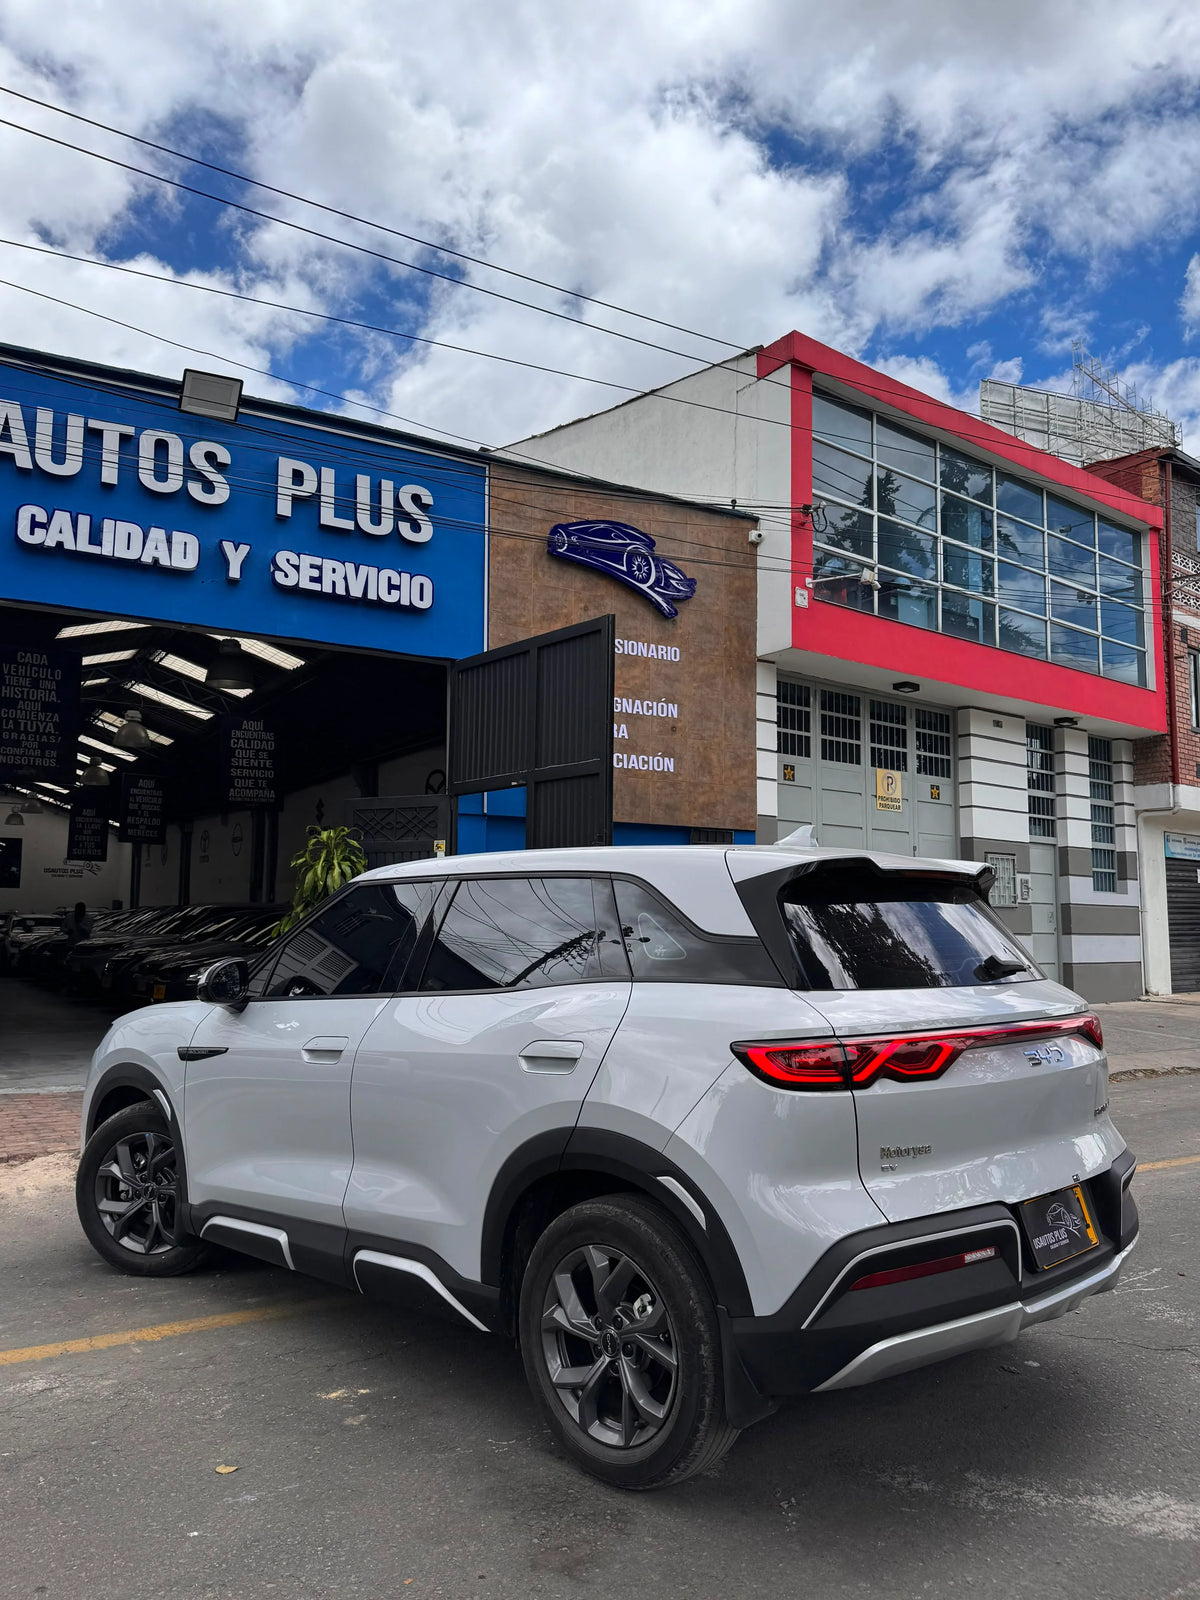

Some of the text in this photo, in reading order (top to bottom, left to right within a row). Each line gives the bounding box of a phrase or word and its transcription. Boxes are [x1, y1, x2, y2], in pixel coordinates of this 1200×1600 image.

[0, 400, 434, 544] AUTOS PLUS
[17, 504, 434, 610] CALIDAD Y SERVICIO
[17, 651, 48, 665] CADA
[3, 663, 62, 680] VEHÍCULO
[5, 675, 57, 691] TIENE UNA
[1, 686, 61, 703] HISTORIA.
[1, 708, 59, 723] COMIENZA
[2, 718, 59, 734] LA TUYA.
[242, 719, 264, 731] AQUÍ
[231, 730, 275, 740] ENCUENTRAS
[21, 741, 39, 749] POR
[230, 738, 275, 750] CALIDAD
[0, 746, 57, 758] CONFIAR EN
[235, 749, 269, 759] QUE SE
[231, 758, 273, 768] SIENTE
[613, 752, 674, 772] CIACIÓN
[230, 768, 274, 778] SERVICIO
[234, 778, 268, 788] QUE TE
[229, 788, 276, 798] ACOMPAÑA
